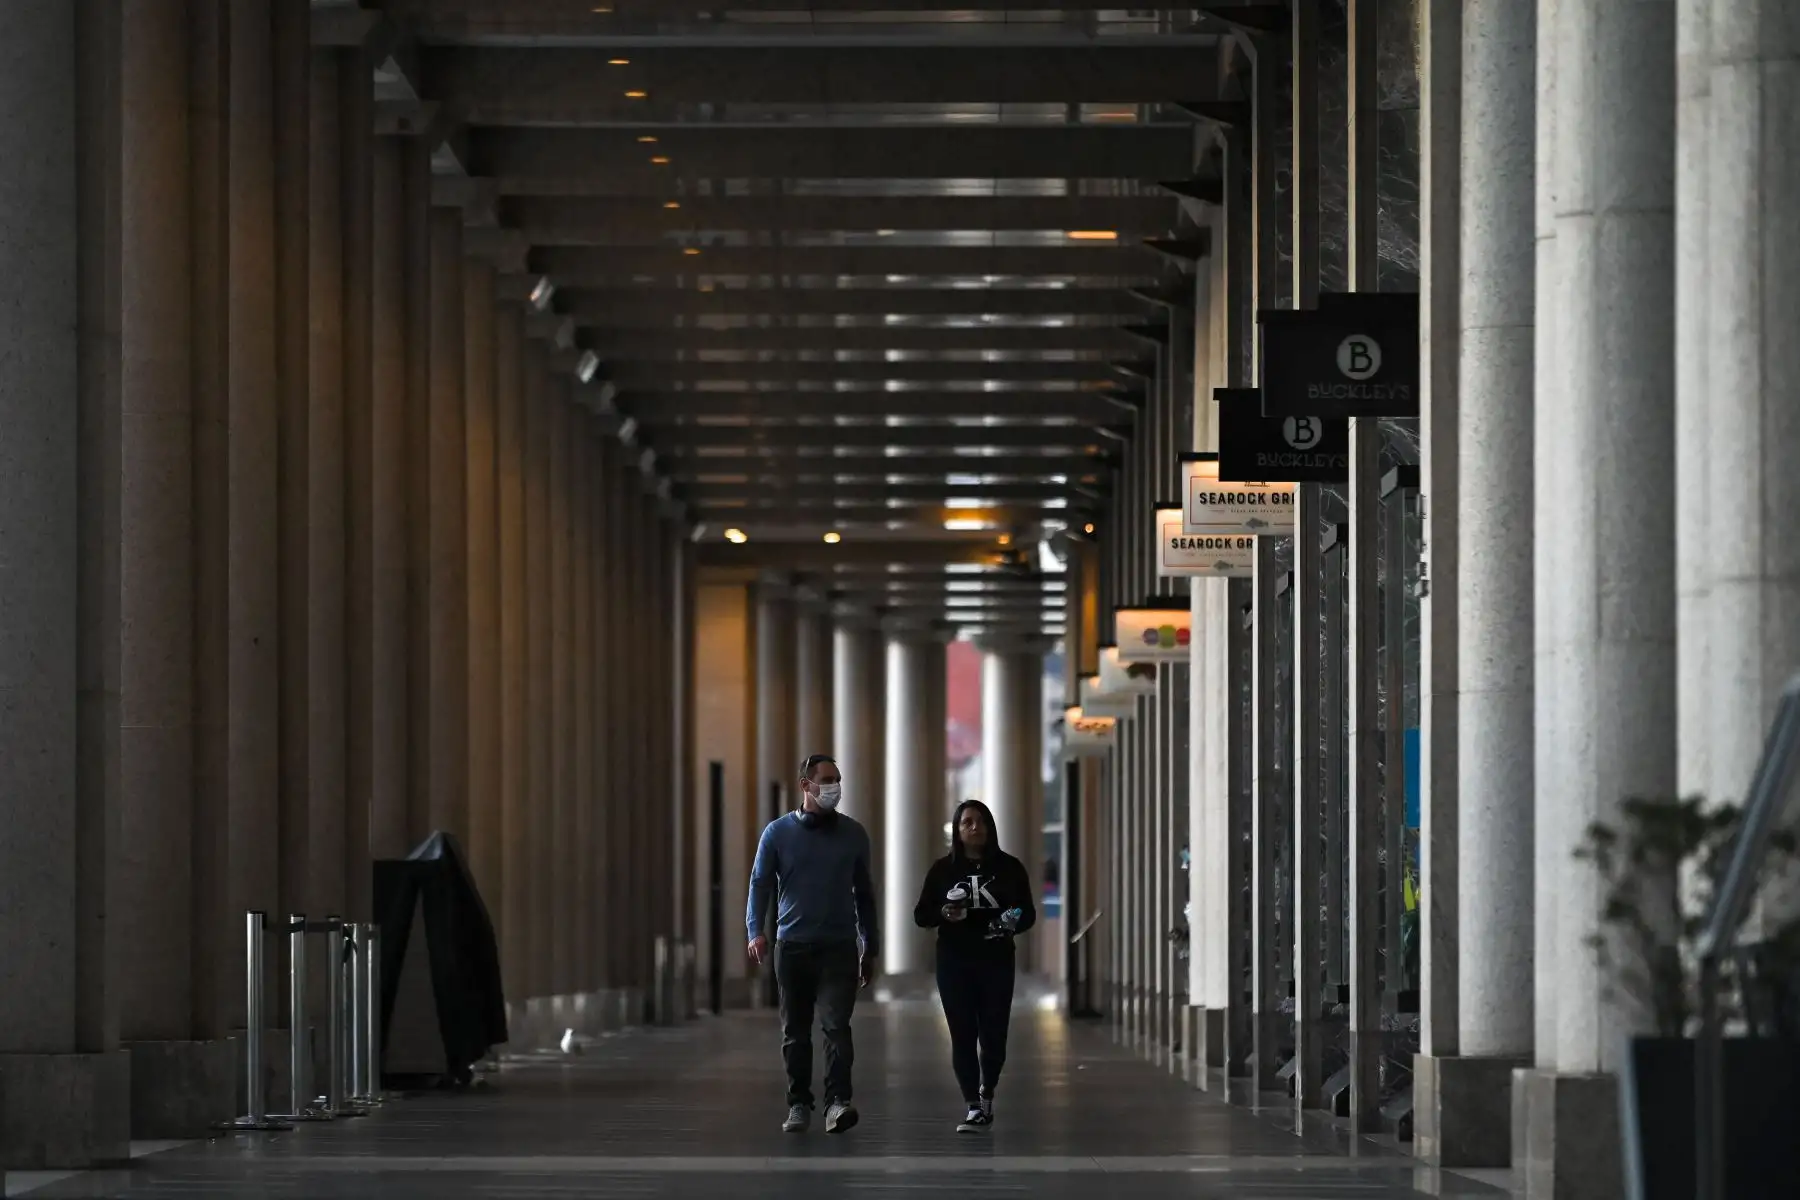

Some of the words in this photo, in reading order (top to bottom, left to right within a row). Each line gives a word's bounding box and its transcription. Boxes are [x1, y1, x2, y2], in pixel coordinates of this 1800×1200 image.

[1348, 342, 1373, 372] B
[1293, 417, 1314, 443] B
[1199, 492, 1266, 505] SEAROCK
[1171, 538, 1232, 549] SEAROCK
